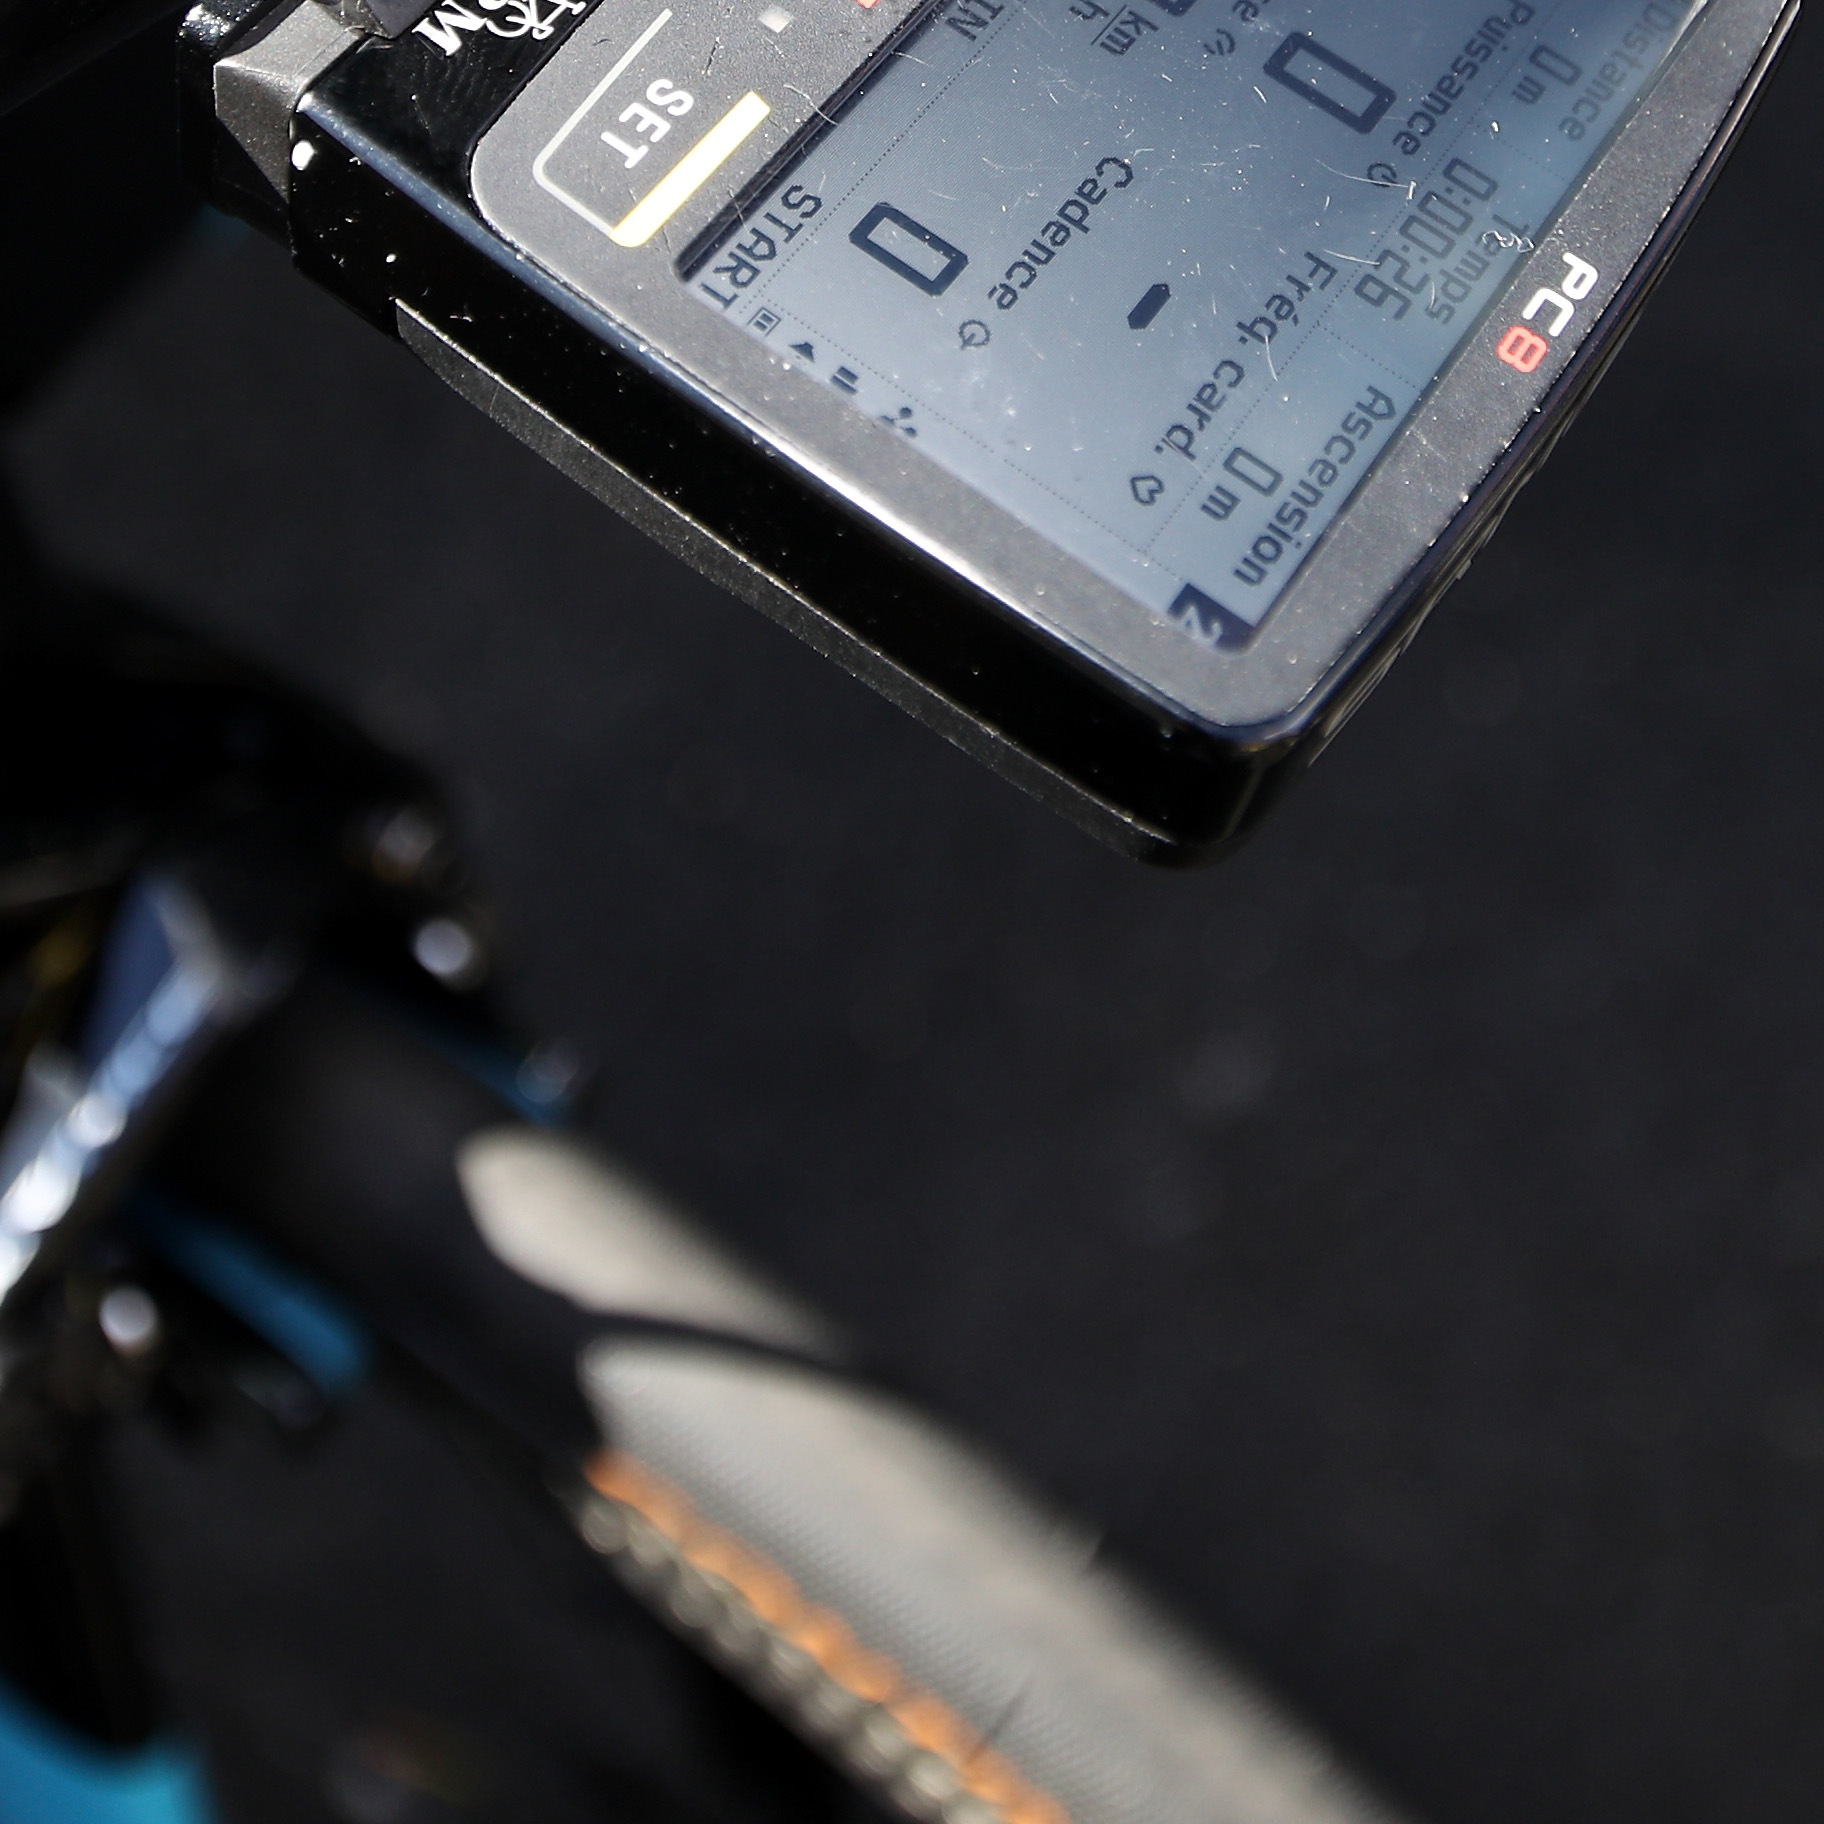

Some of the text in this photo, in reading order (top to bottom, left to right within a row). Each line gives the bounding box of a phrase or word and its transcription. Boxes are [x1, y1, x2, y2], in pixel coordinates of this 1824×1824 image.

[1098, 10, 1159, 56] km
[1262, 31, 1395, 133] 0
[1511, 44, 1581, 104] 0 m
[1557, 2, 1678, 140] Distance
[600, 78, 694, 168] SET
[700, 184, 823, 309] START
[849, 202, 968, 295] 0
[988, 156, 1133, 309] Cadence
[1353, 157, 1498, 319] 0:00:26
[1424, 212, 1530, 324] Temps
[1154, 251, 1337, 459] Fréq. card.
[1496, 252, 1599, 373] PC8
[1200, 446, 1281, 520] 0 m
[1232, 385, 1394, 584] Ascension
